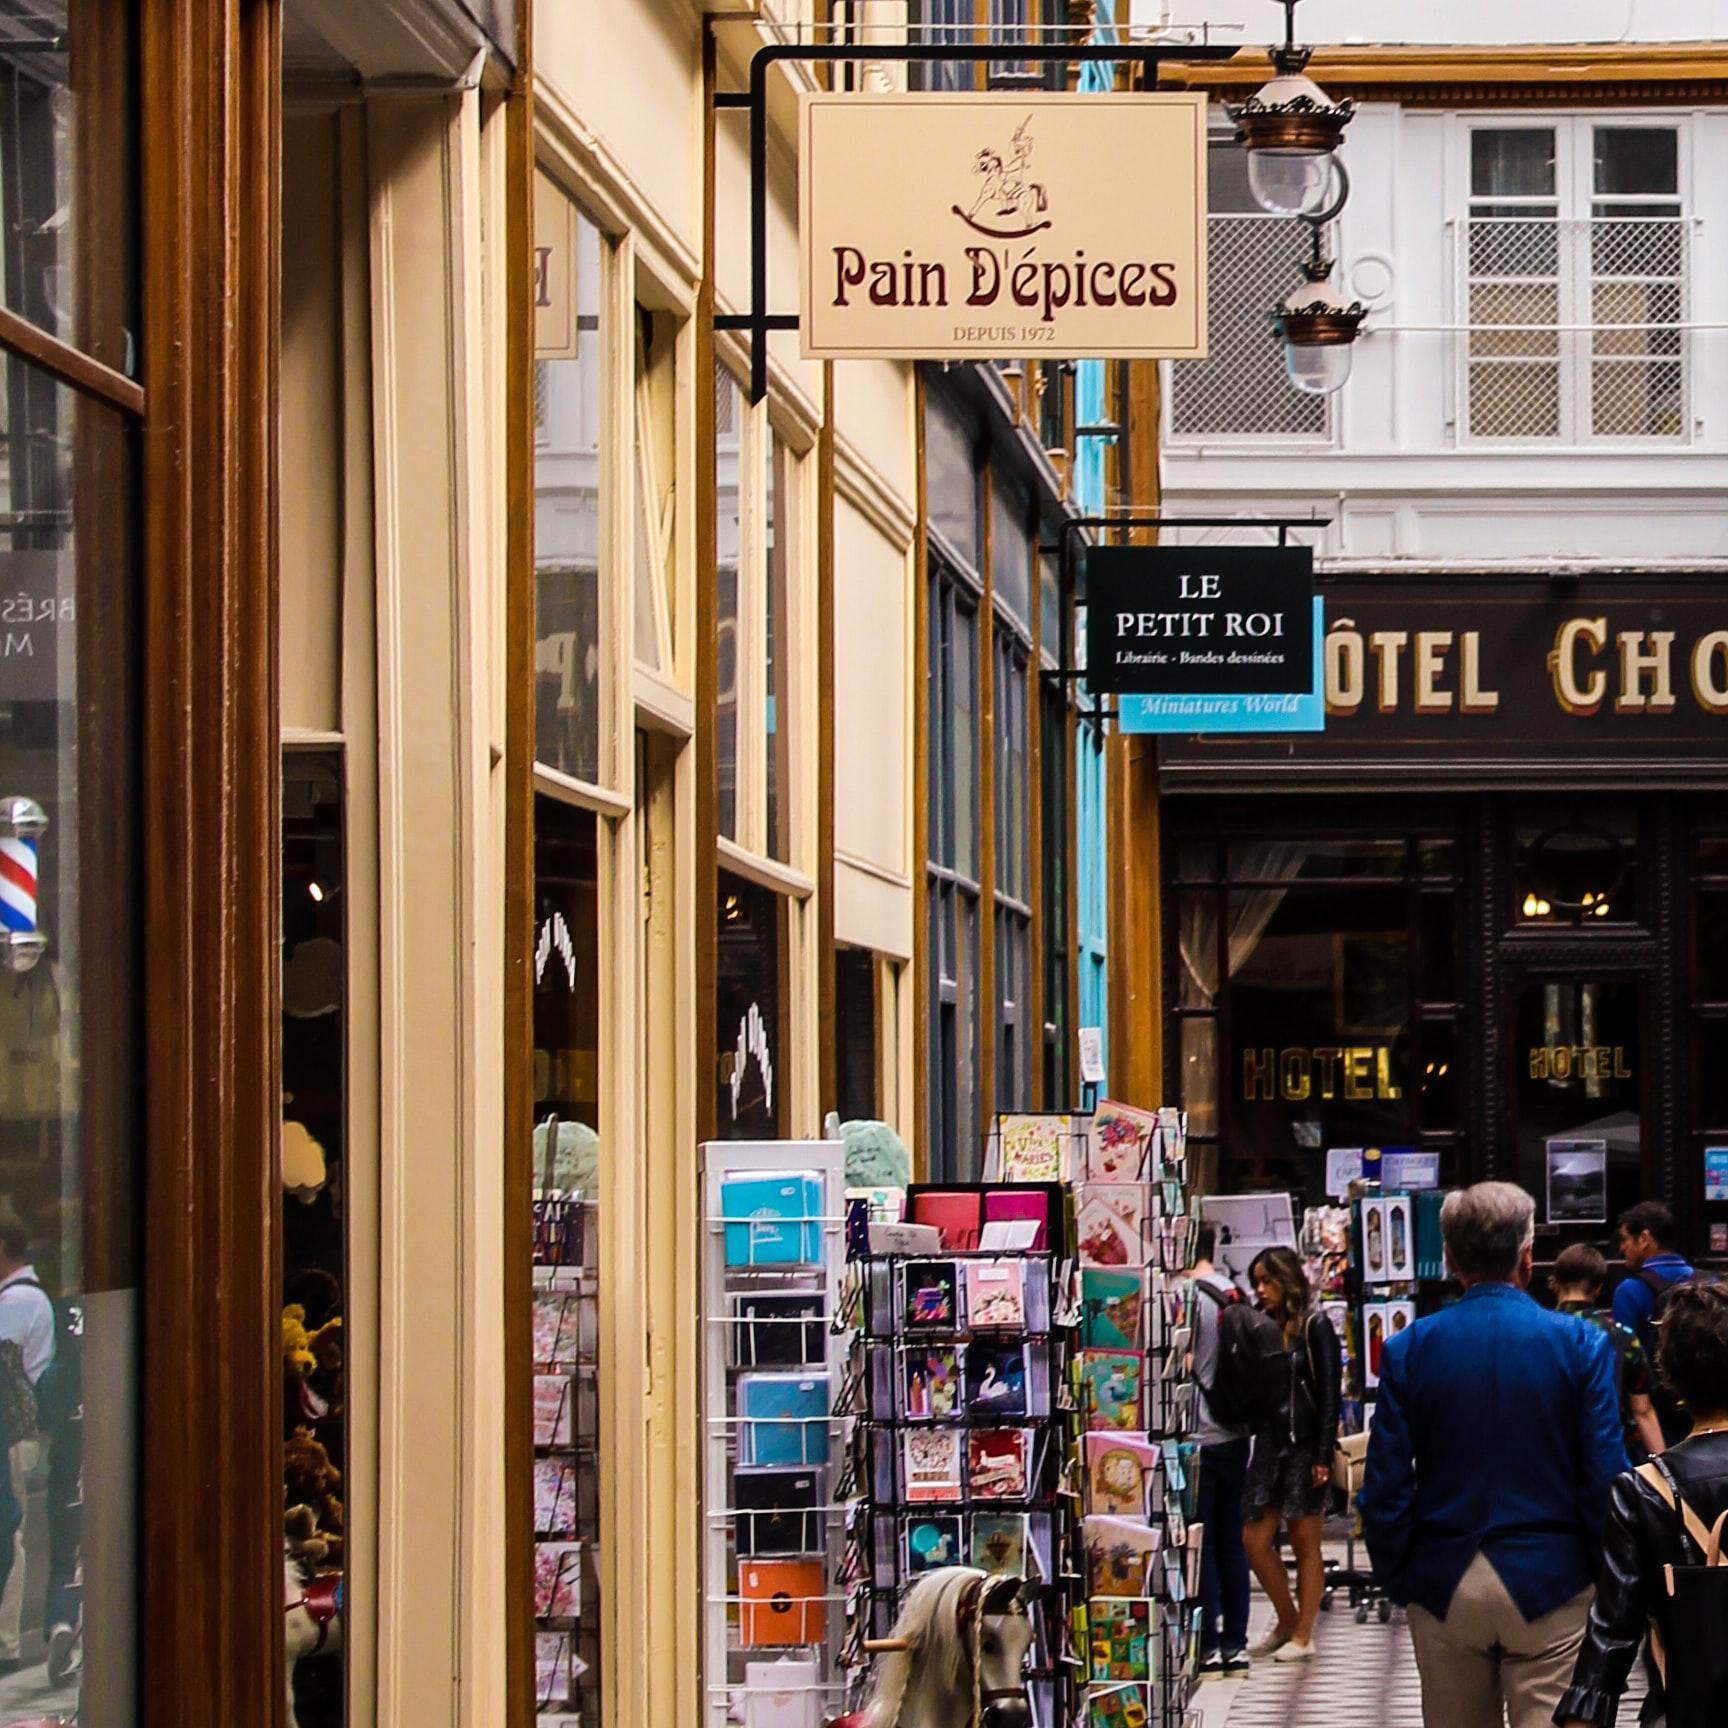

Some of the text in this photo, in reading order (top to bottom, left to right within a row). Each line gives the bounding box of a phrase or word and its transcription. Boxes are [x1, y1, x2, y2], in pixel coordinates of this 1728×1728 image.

[832, 246, 1177, 322] Pain D'épices
[953, 326, 1055, 341] DEPUIS 1972
[1179, 574, 1222, 599] LE
[1116, 612, 1284, 637] PETIT ROI
[1115, 650, 1168, 664] Librairie
[1180, 650, 1224, 664] Bandes
[1227, 650, 1285, 664] dessinées
[1322, 617, 1499, 715] ÔTEL
[1140, 693, 1303, 715] Miniatures World
[1242, 1047, 1402, 1101] HOTEL
[1529, 1045, 1632, 1079] HOTEL
